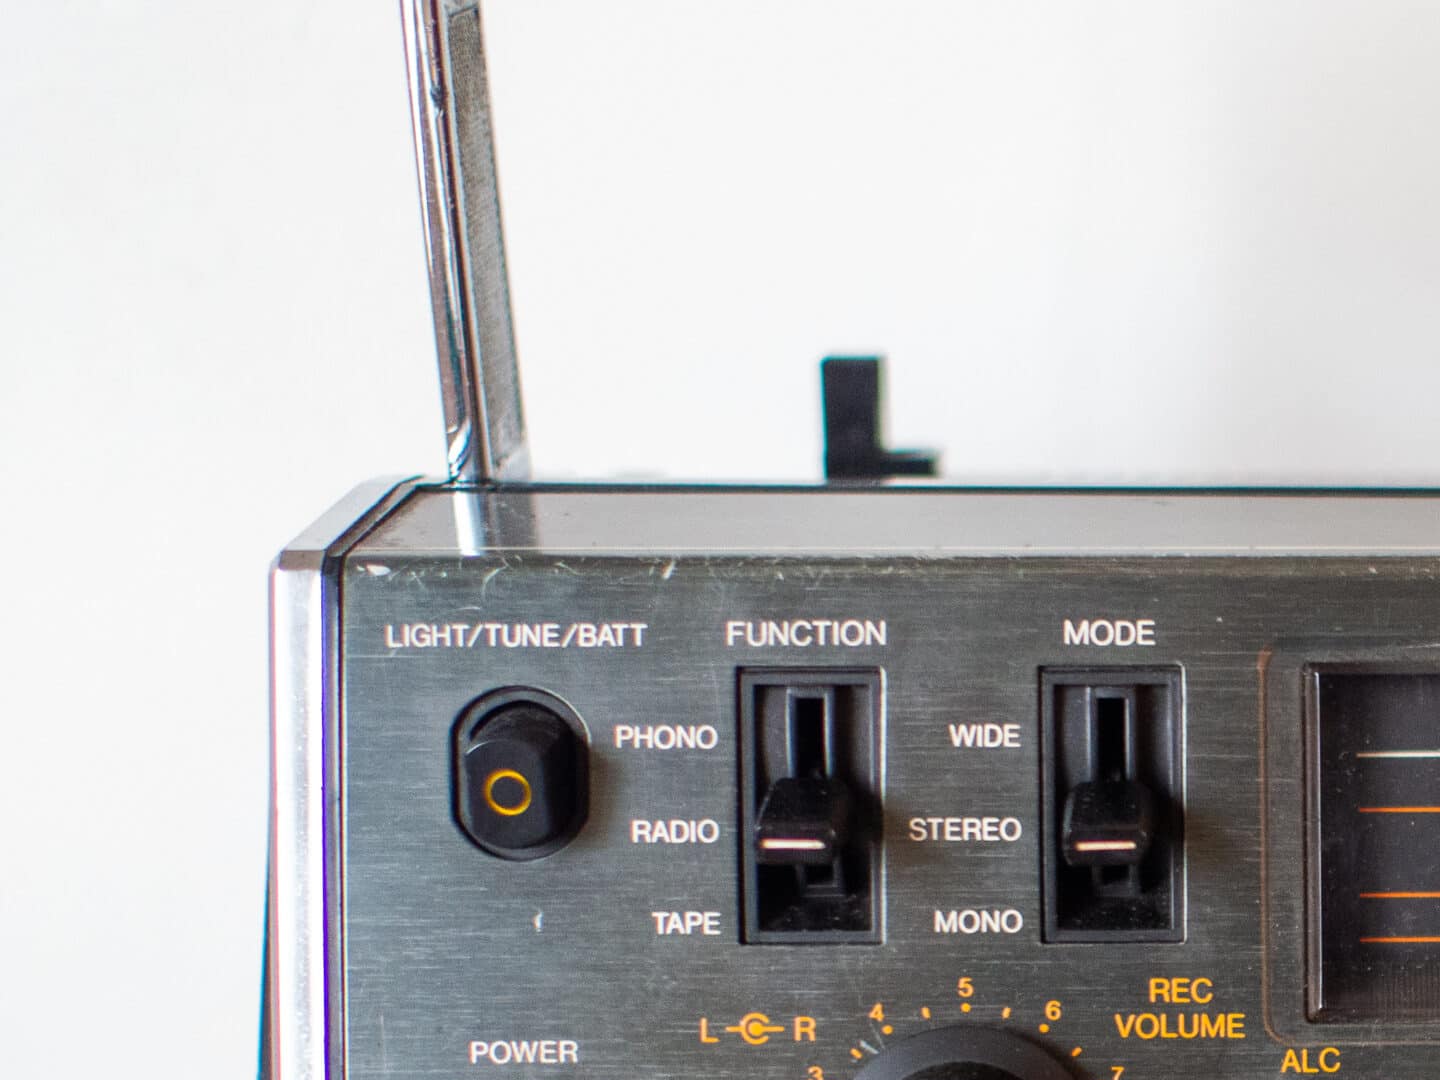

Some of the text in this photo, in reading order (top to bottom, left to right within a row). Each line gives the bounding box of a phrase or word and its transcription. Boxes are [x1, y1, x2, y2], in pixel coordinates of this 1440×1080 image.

[385, 622, 649, 649] LIGHT/TUNE/BATT
[725, 619, 887, 648] FUNCTION
[1063, 619, 1156, 647] MODE
[613, 724, 719, 750] PHONO
[948, 723, 1022, 748] WIDE
[630, 818, 720, 844] RADIO
[909, 816, 1023, 842] STEREO
[651, 910, 722, 936] TAPE
[933, 908, 1024, 934] MONO
[957, 976, 974, 998] 5
[1148, 977, 1214, 1004] REC
[868, 1002, 885, 1022] 4
[1044, 999, 1062, 1021] 6
[793, 1015, 817, 1042] R
[1114, 1012, 1246, 1040] VOLUME
[468, 1039, 579, 1065] POWER
[1279, 1047, 1341, 1074] ALC
